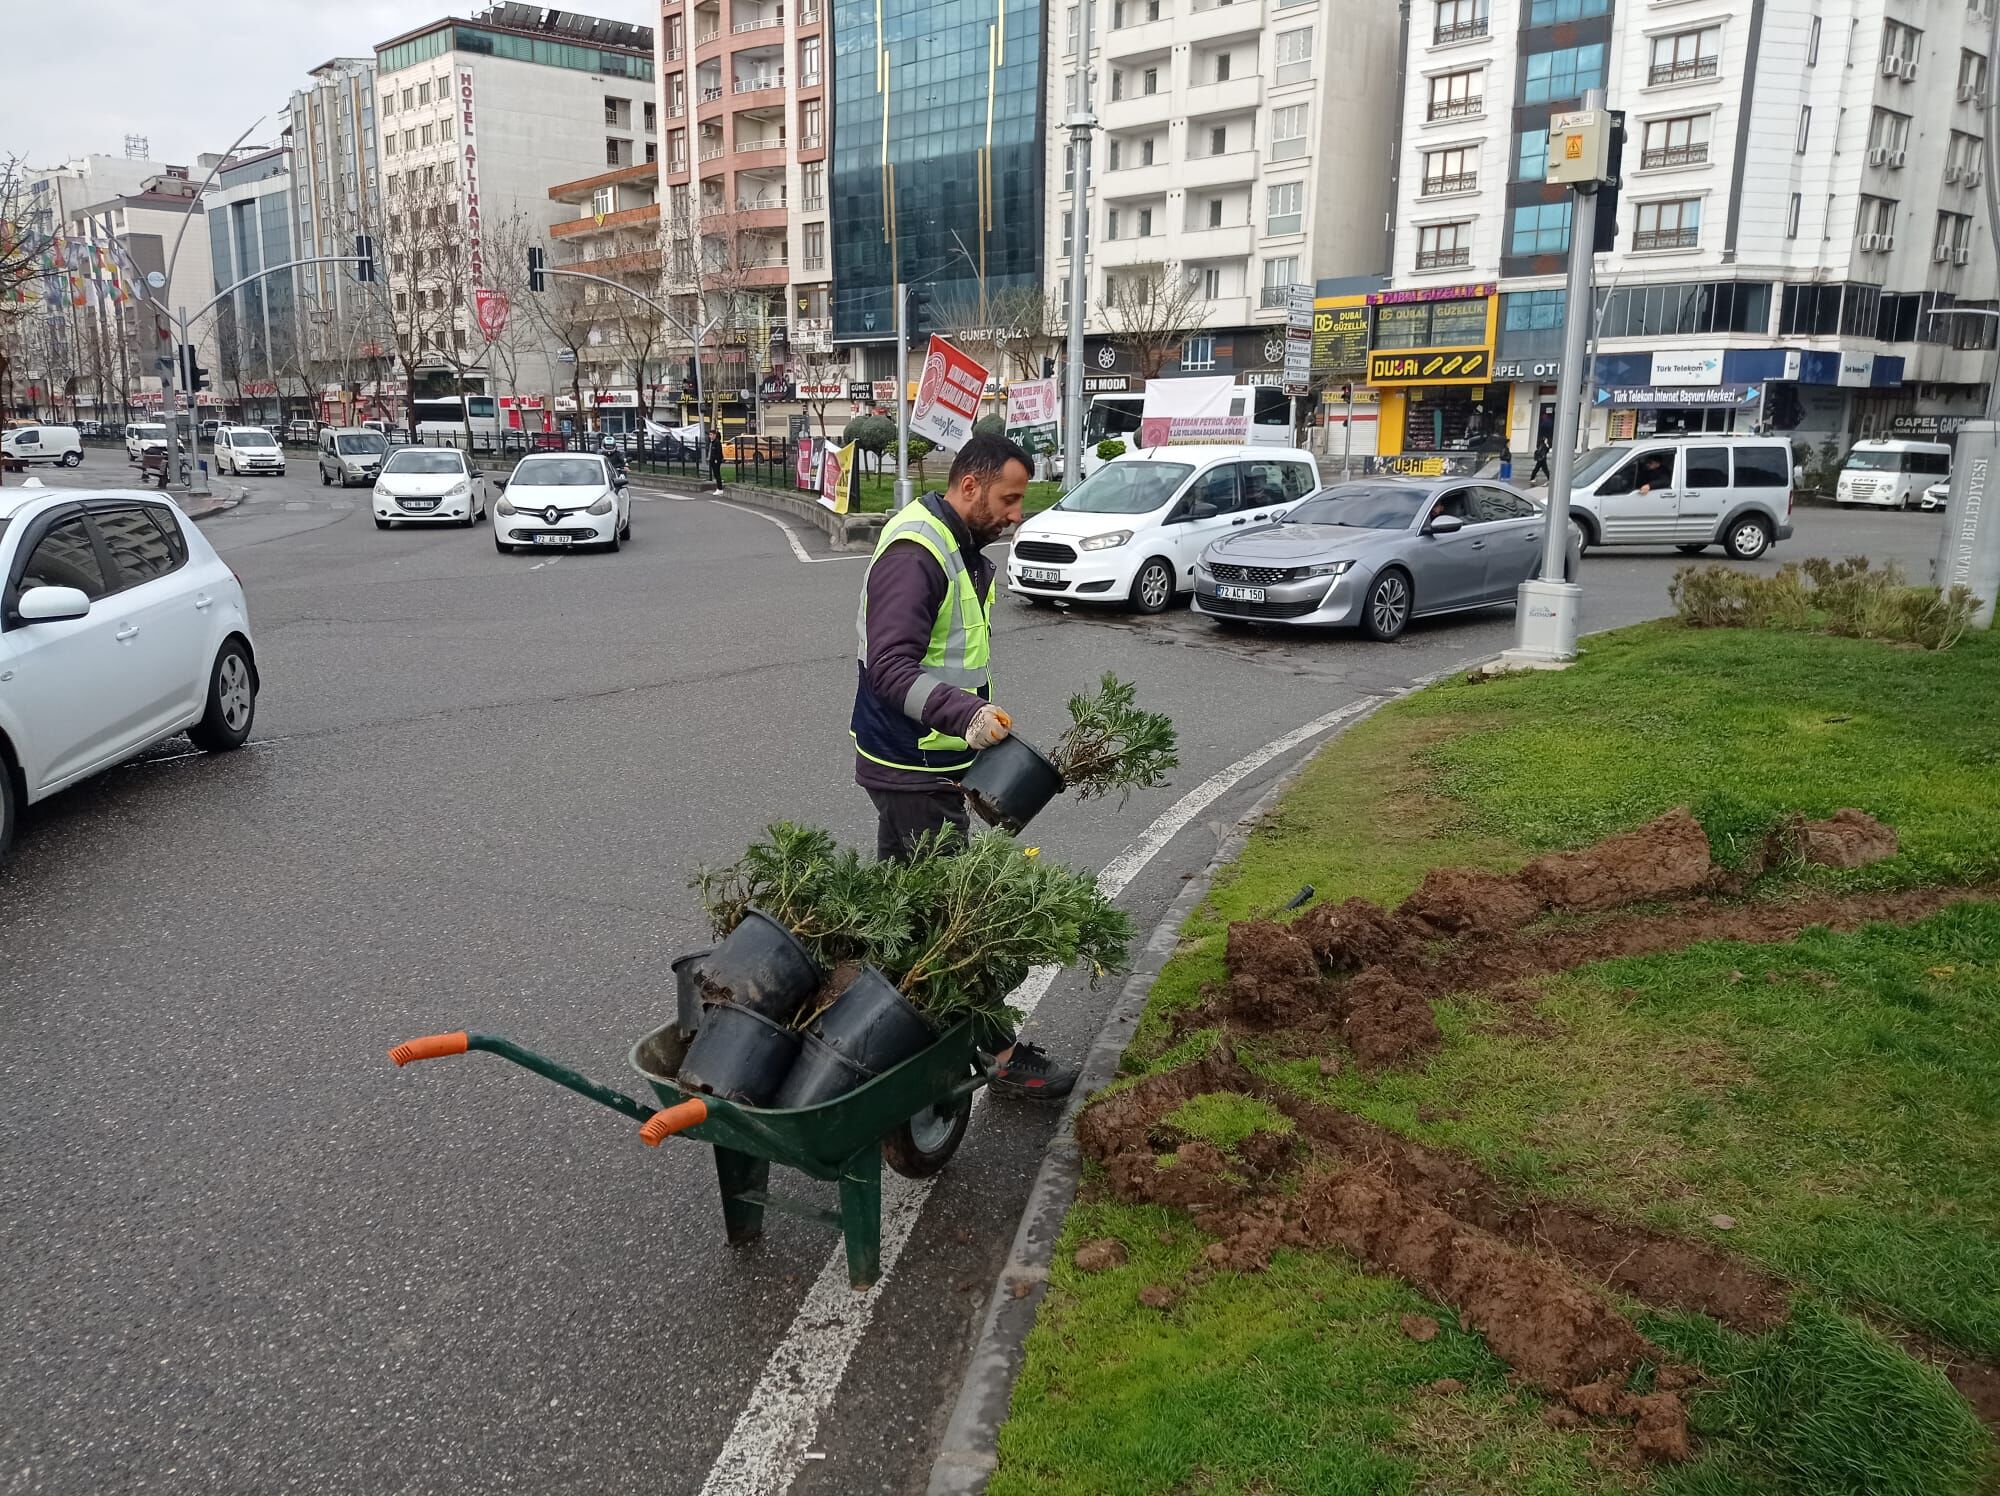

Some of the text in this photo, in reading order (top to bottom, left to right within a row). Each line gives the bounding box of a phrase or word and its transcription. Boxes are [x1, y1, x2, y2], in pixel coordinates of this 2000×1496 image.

[461, 73, 473, 136] HOTEL
[1314, 314, 1333, 332] DG
[1333, 320, 1367, 331] GÜZELLİK
[1674, 364, 1703, 372] Telekom
[1085, 378, 1126, 390] EN MODA
[1249, 374, 1261, 386] EN
[1614, 387, 1736, 405] Türk Telekom İnternet Başvuru Merkezi
[1172, 417, 1198, 427] BATMAN
[1199, 417, 1223, 426] PETROL
[1895, 417, 1938, 427] GAPEL
[1961, 458, 1989, 541] BELEDİYESİ
[1025, 568, 1033, 578] 72
[1221, 586, 1263, 600] 72 ACT 150
